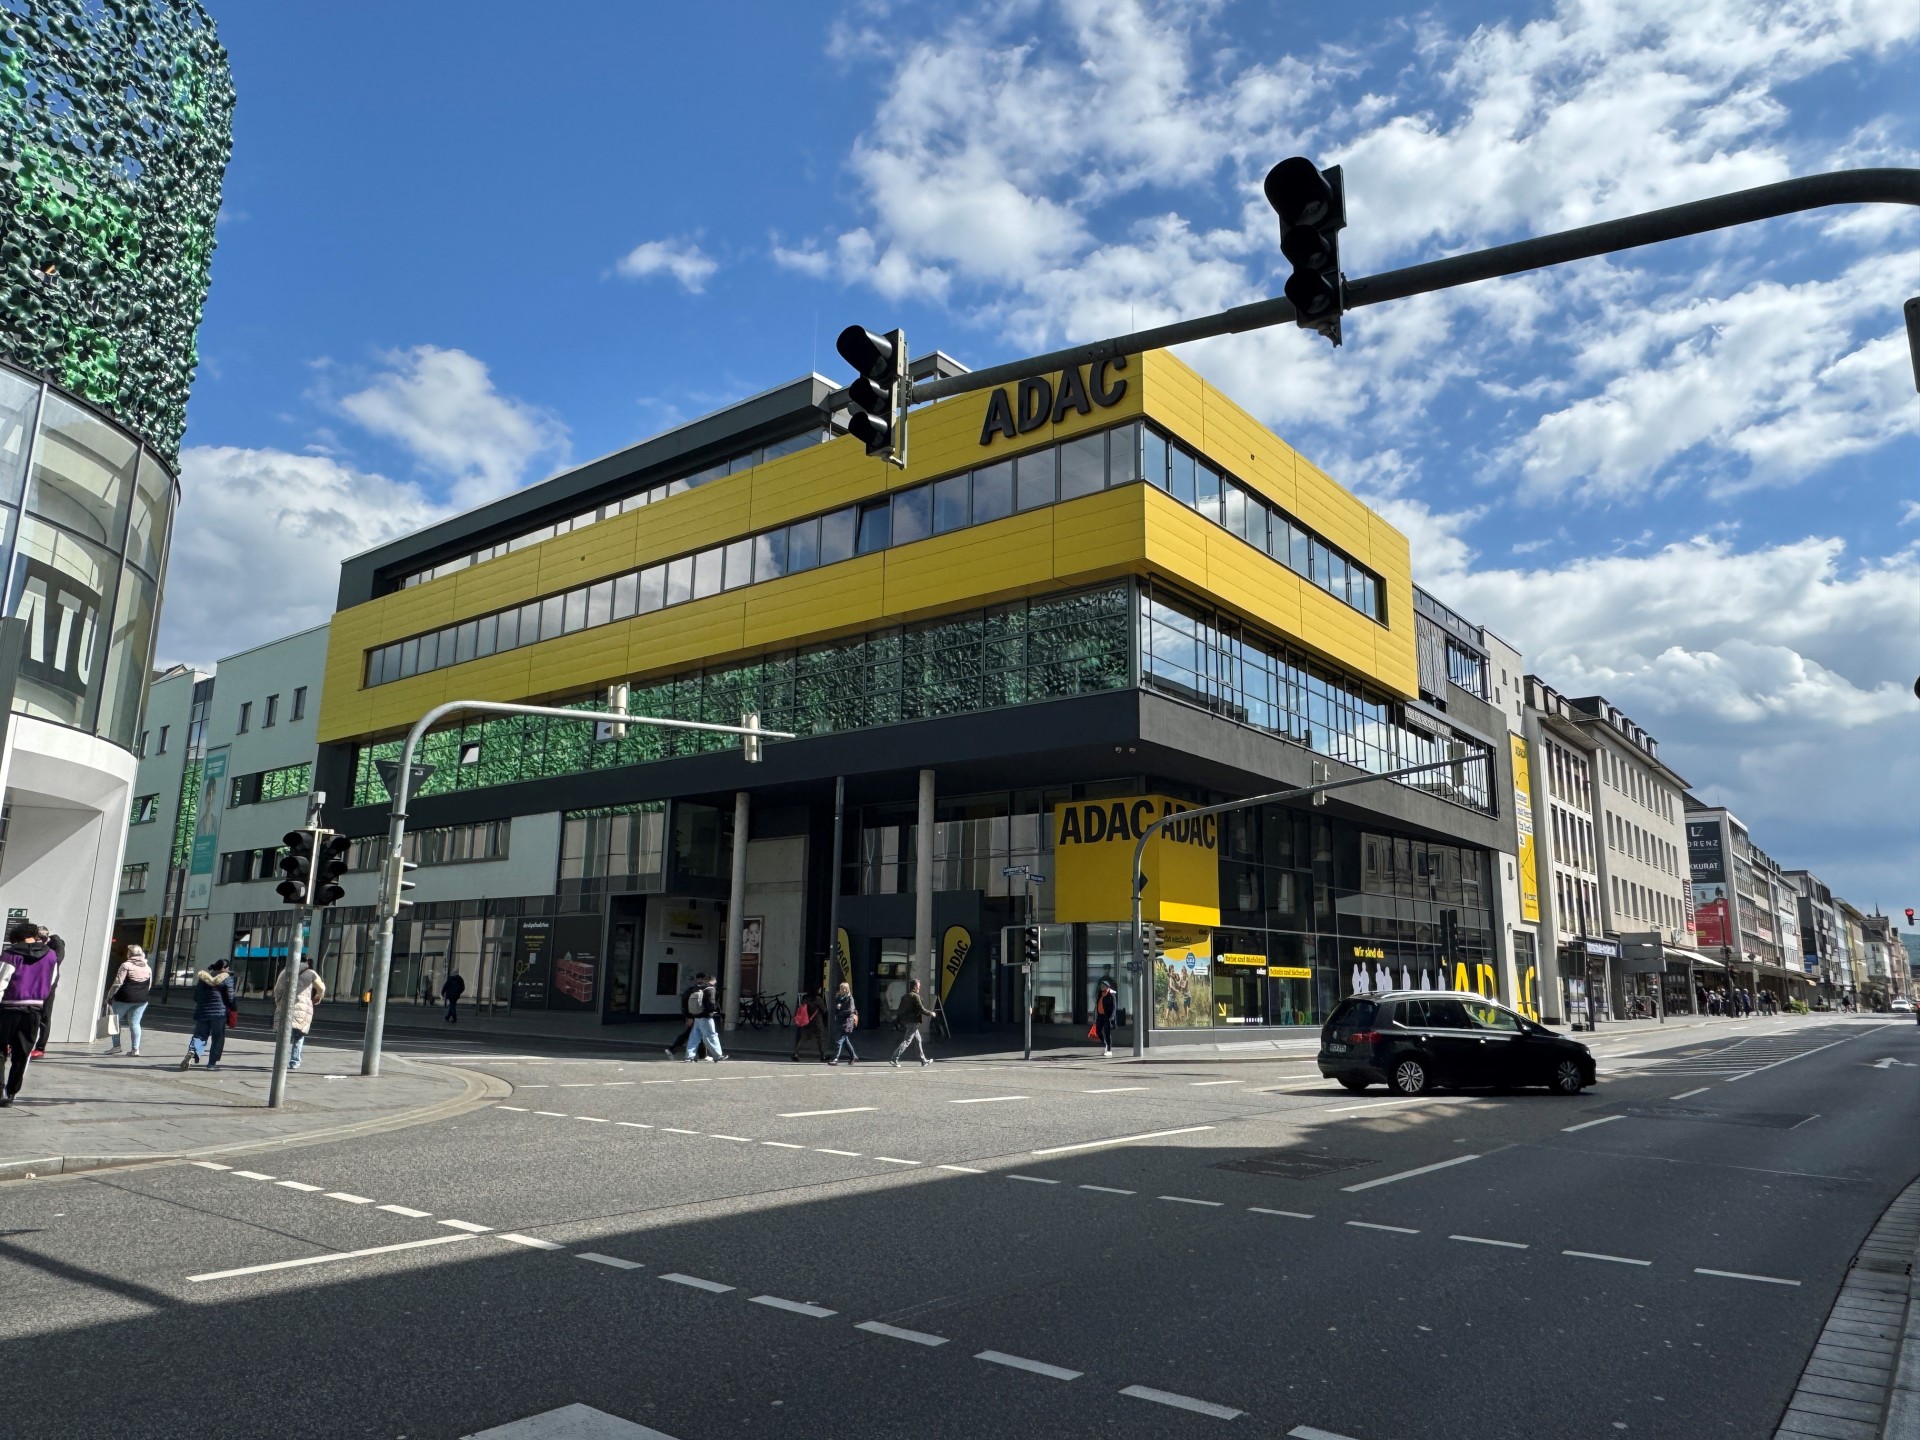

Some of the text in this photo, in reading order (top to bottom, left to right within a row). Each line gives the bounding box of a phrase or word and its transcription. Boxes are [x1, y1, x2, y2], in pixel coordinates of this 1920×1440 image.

[979, 355, 1128, 446] ADAC
[1059, 800, 1155, 845] ADAC
[1161, 801, 1216, 849] ADAC
[946, 940, 968, 976] ADAC
[1354, 946, 1384, 958] Wir sind da
